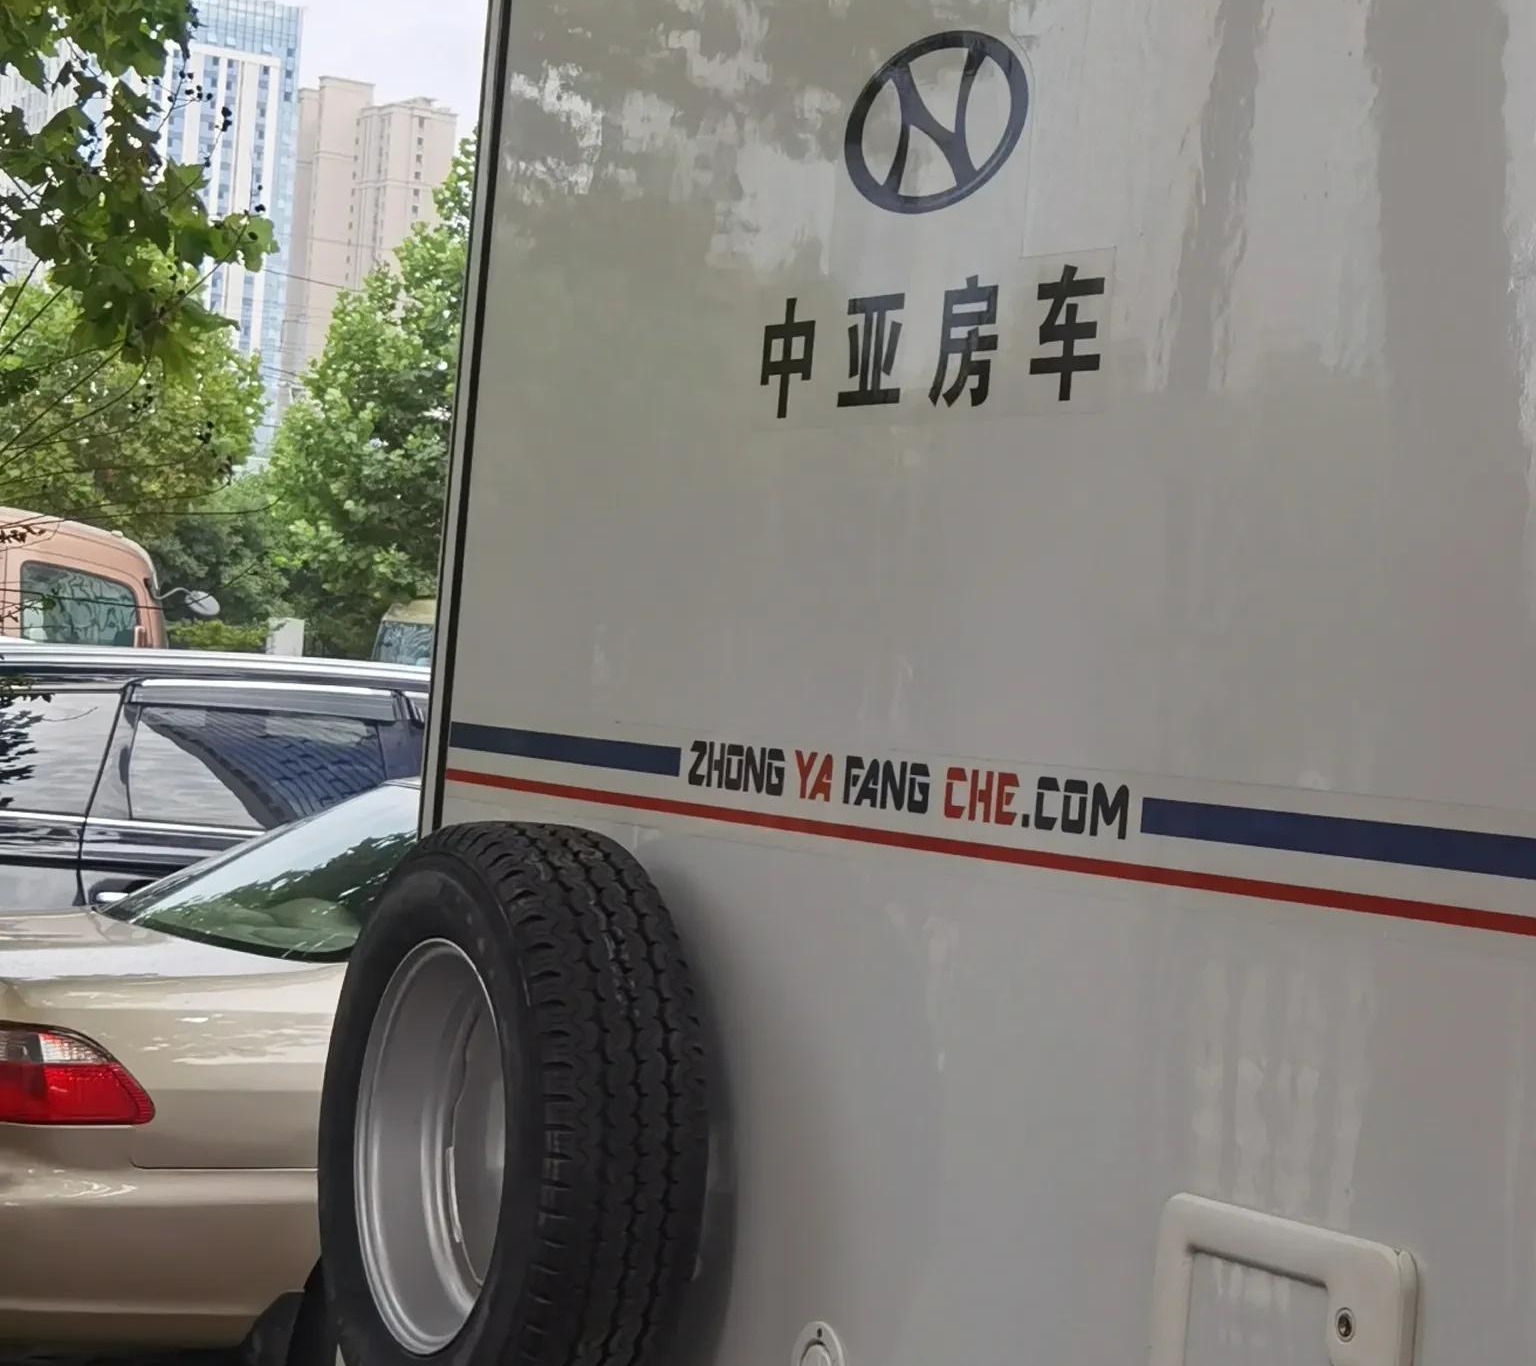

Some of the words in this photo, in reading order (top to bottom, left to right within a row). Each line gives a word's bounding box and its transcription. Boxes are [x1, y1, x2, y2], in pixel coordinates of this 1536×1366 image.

[760, 265, 1105, 419] 中亚房车
[688, 740, 786, 796] ZHONG
[795, 749, 834, 802] YA
[842, 755, 931, 814] FANG
[943, 766, 1130, 840] CHE.COM
